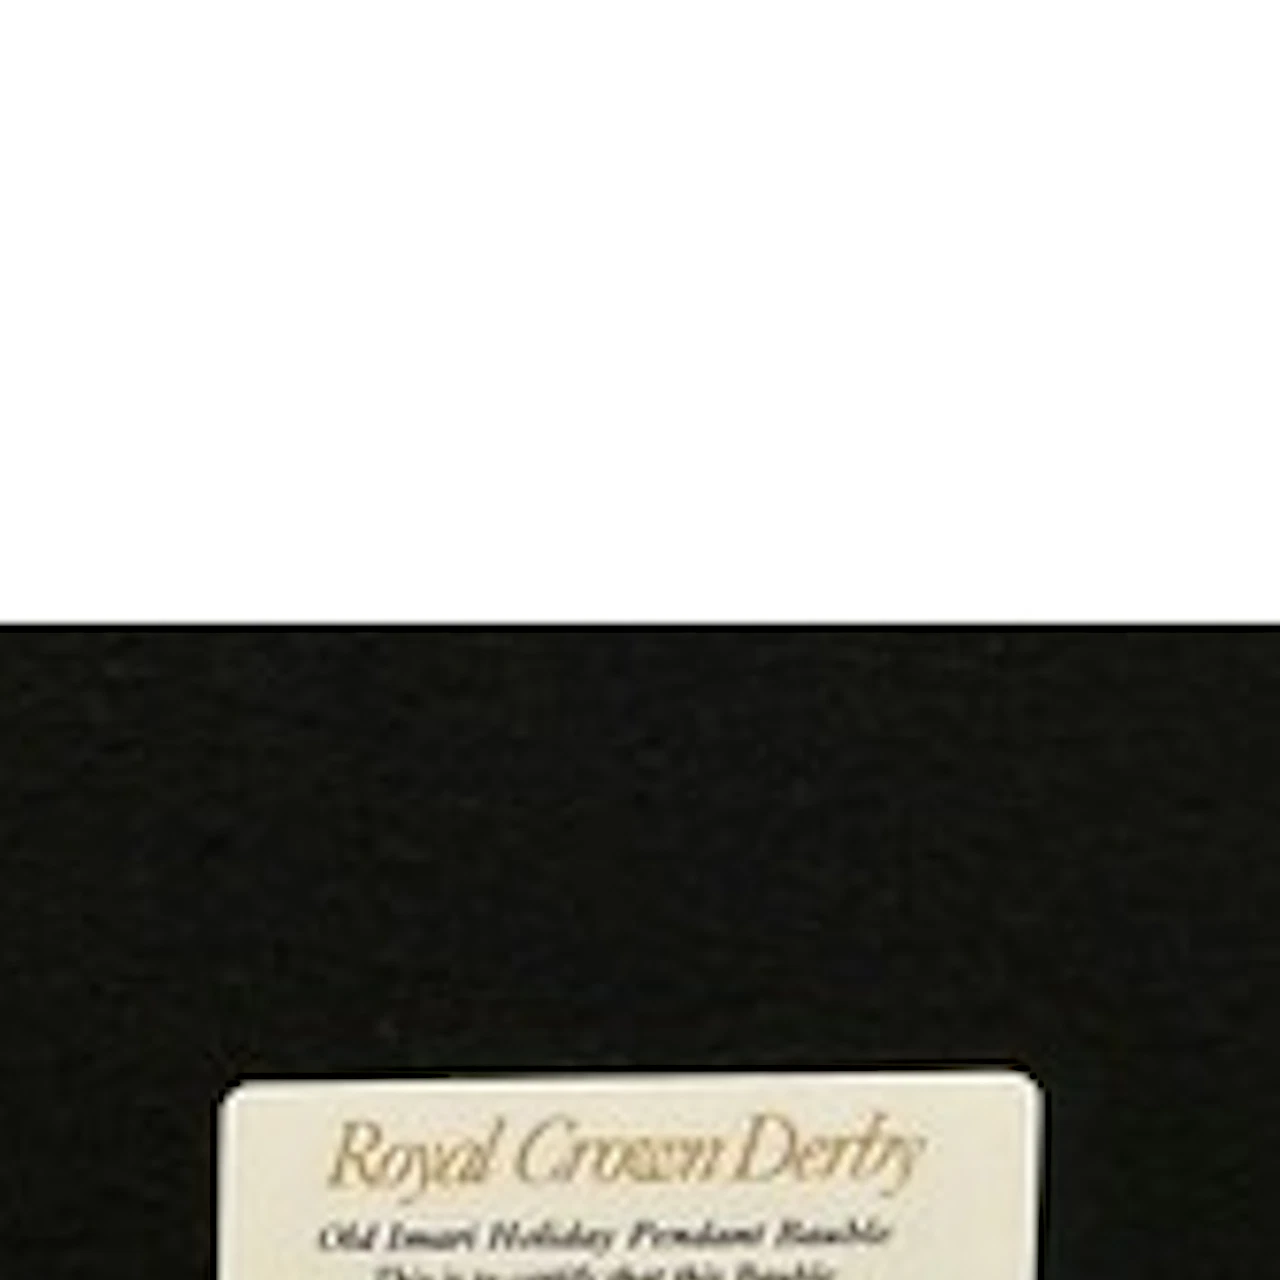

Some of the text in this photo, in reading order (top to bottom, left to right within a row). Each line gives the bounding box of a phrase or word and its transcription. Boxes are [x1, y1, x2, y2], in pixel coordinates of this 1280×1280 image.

[327, 1111, 928, 1205] Royal Crown Derby
[318, 1220, 385, 1252] Old
